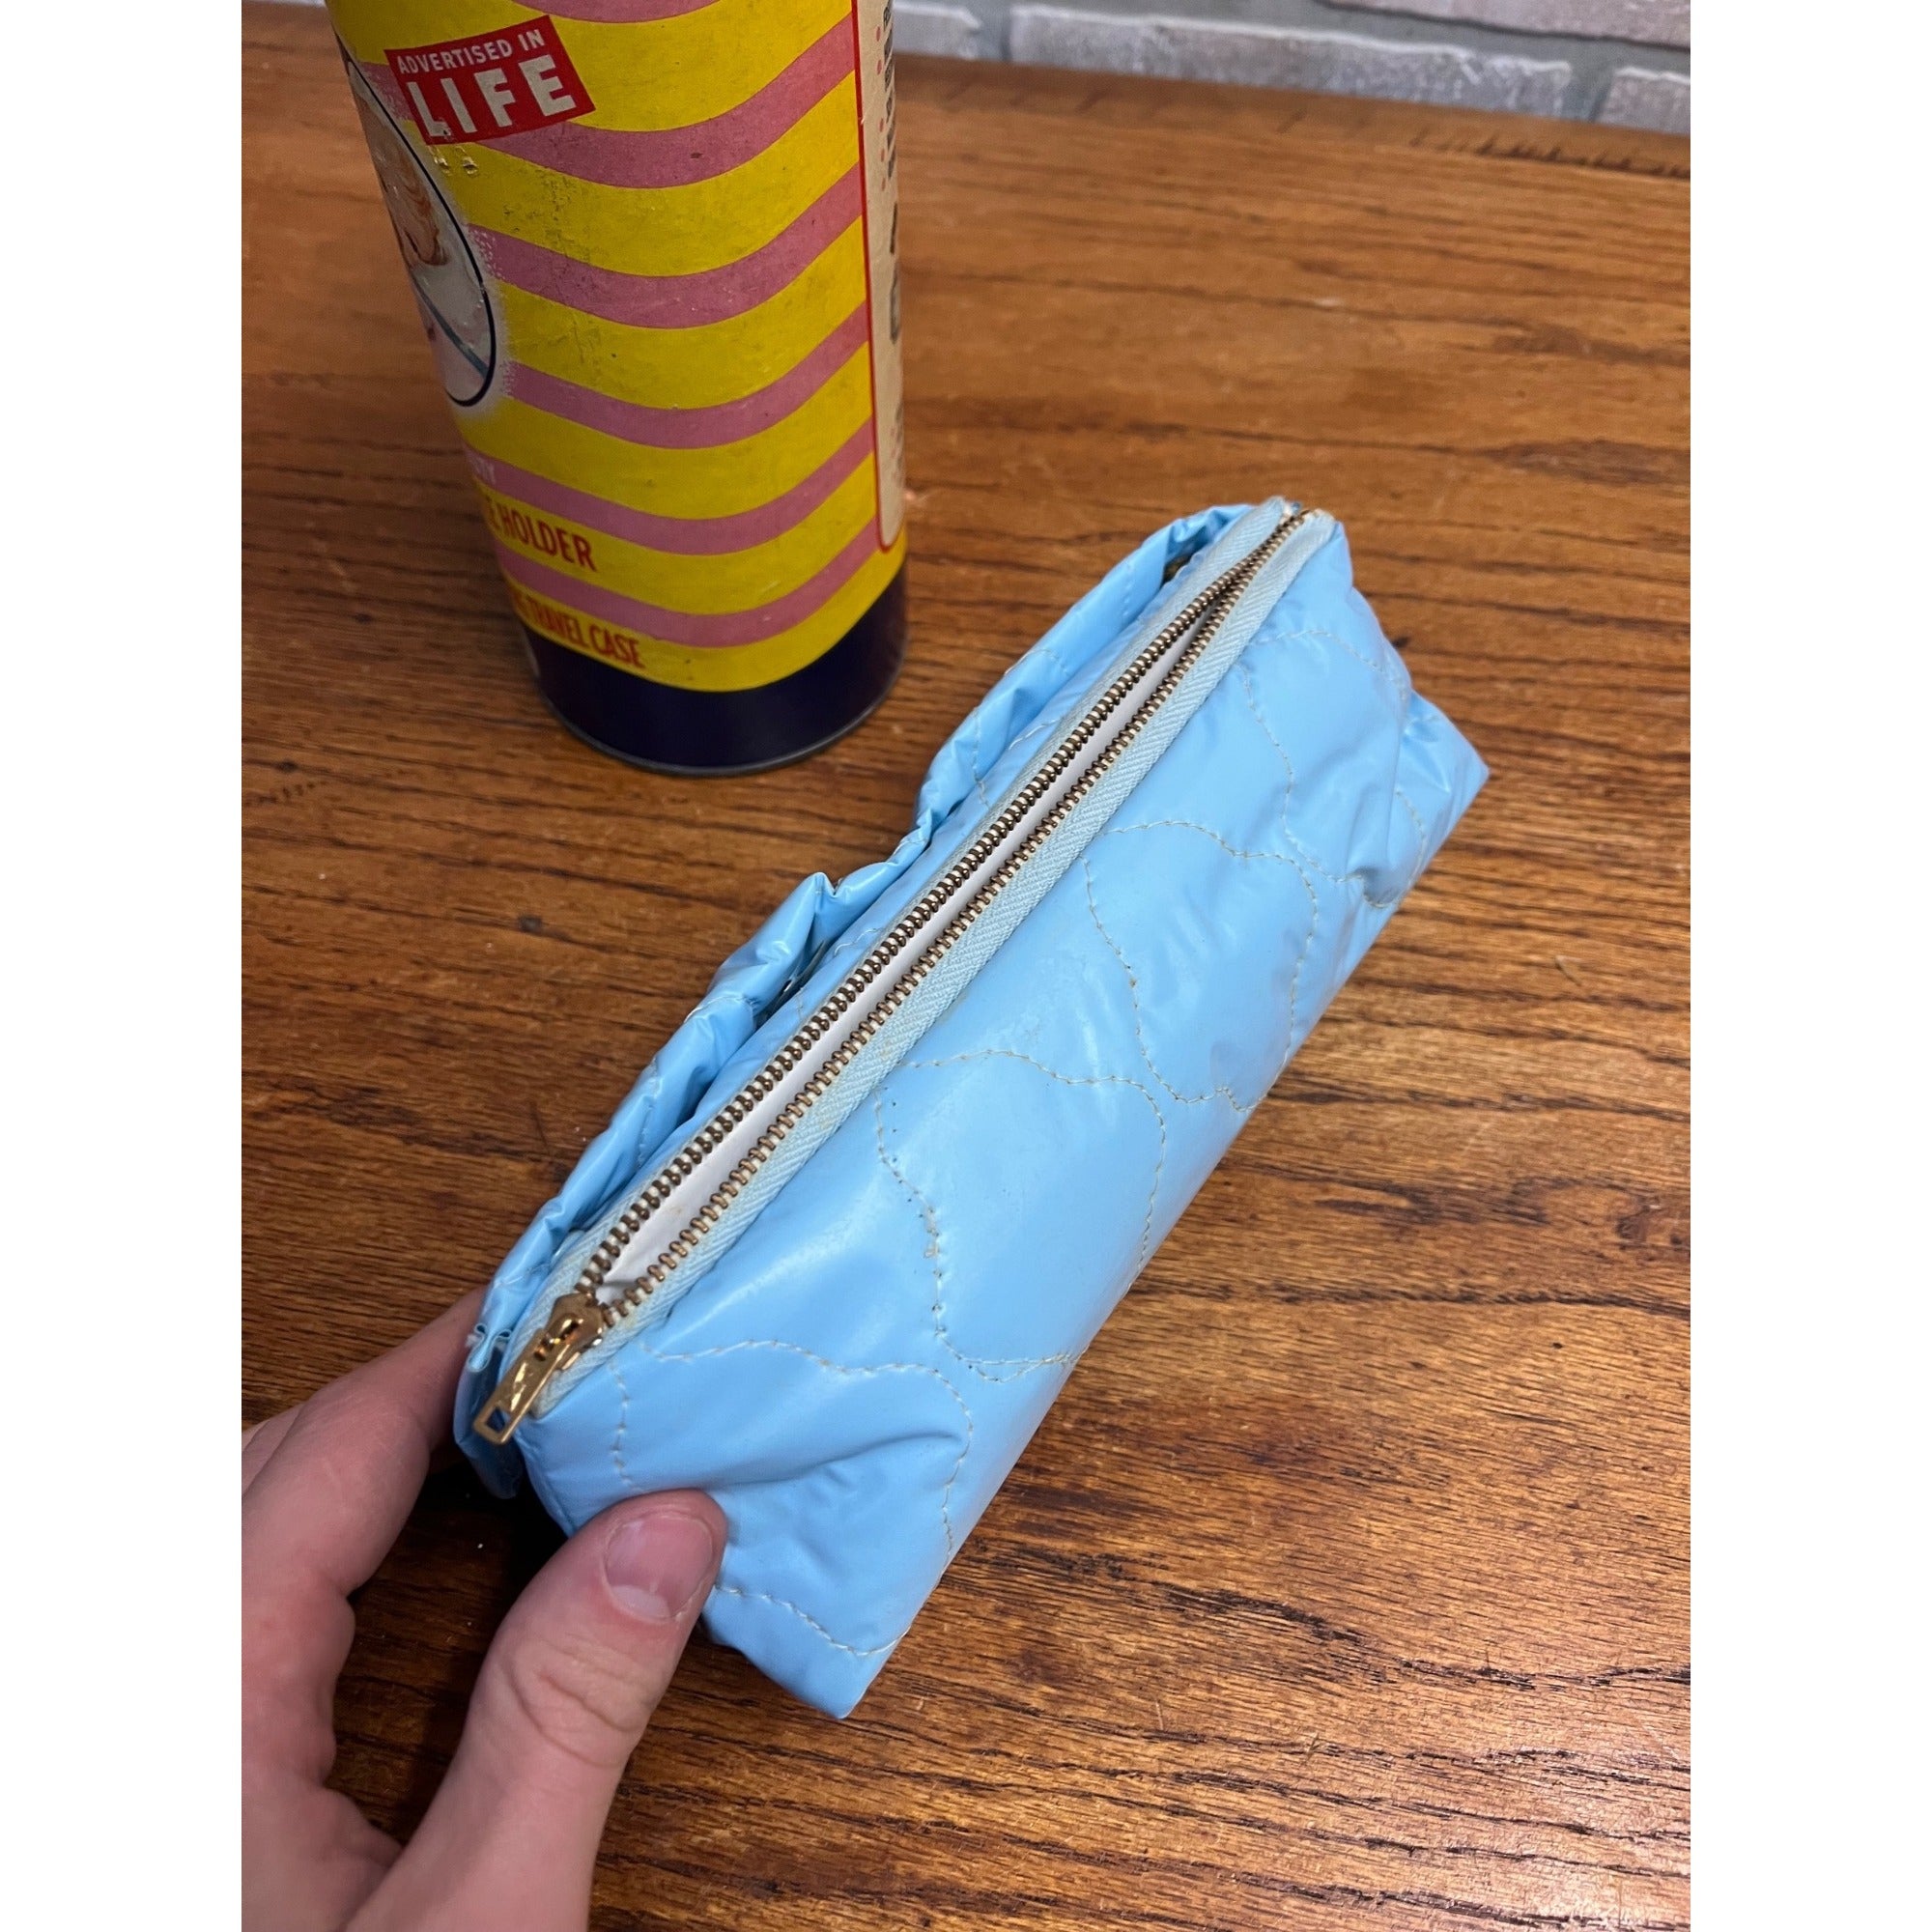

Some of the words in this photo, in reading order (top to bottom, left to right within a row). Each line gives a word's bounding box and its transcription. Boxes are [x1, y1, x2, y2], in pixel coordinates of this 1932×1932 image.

[397, 40, 513, 74] ADVERTISED
[518, 29, 546, 51] IN
[406, 54, 577, 137] LIFE
[496, 501, 597, 572] HOLDER
[589, 624, 646, 670] CASE
